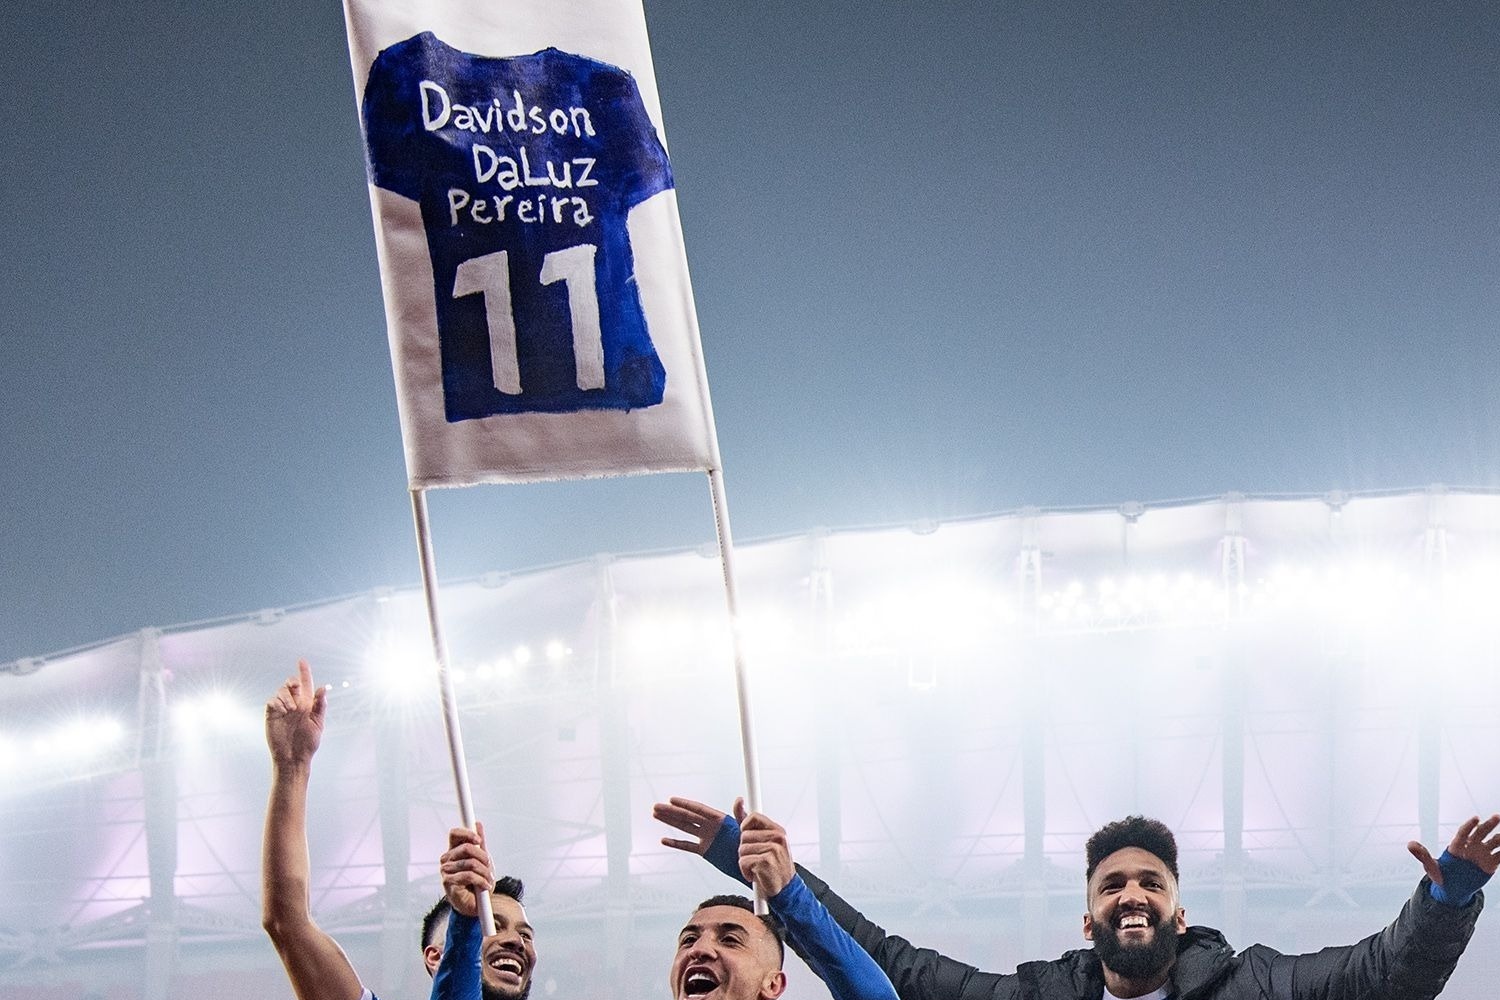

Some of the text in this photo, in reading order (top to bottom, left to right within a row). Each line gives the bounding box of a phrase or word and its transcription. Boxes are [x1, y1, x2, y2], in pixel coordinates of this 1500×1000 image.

[419, 80, 596, 137] Davidson
[472, 144, 599, 191] DaLuz
[447, 188, 595, 227] Pereira
[452, 244, 606, 396] 11
